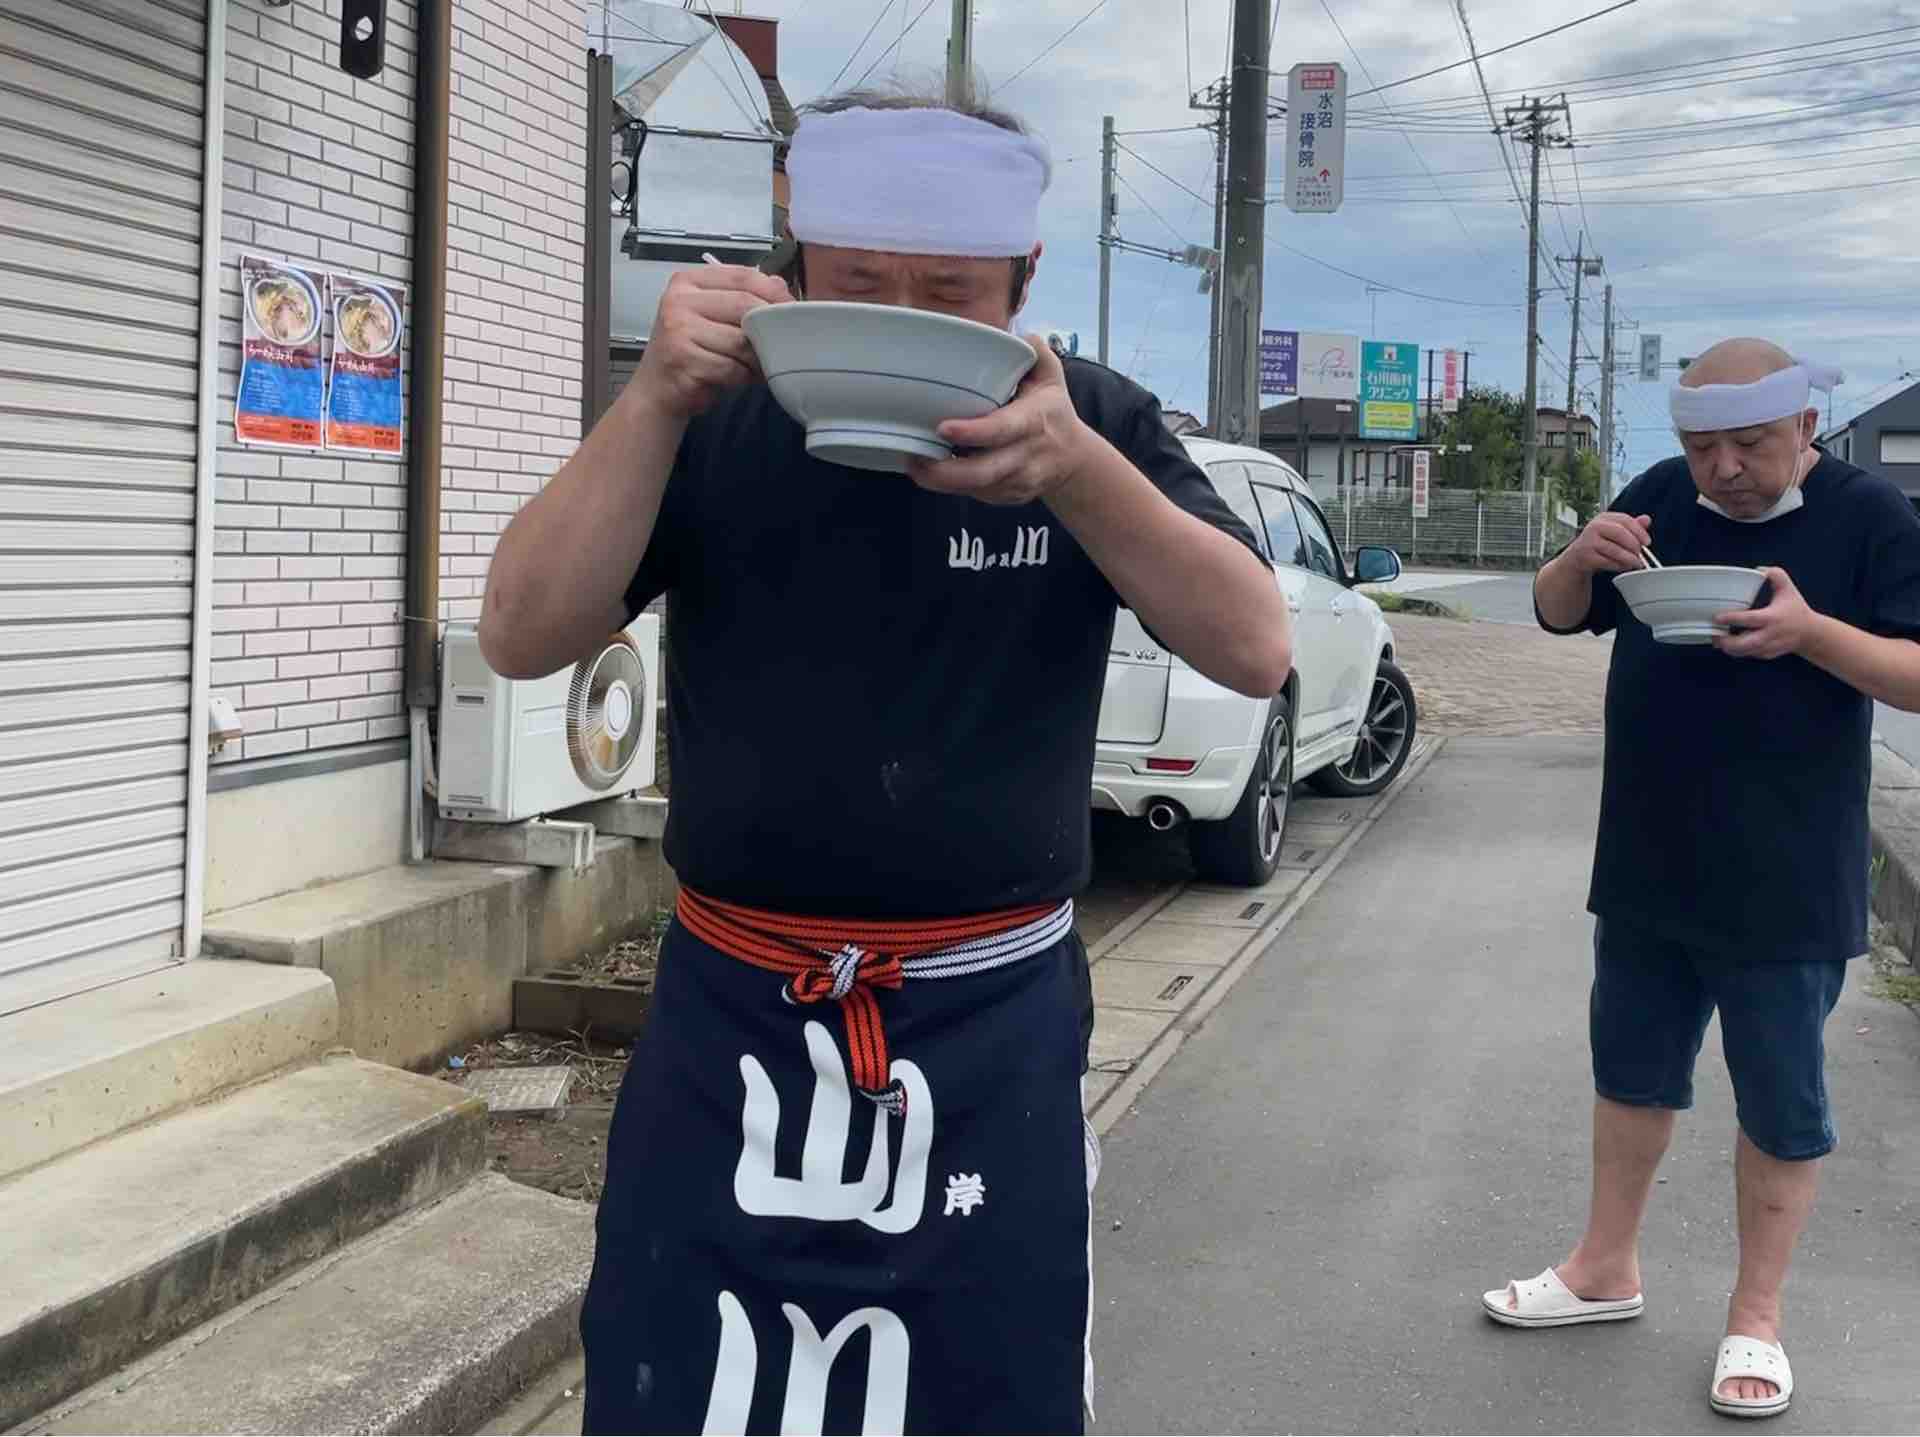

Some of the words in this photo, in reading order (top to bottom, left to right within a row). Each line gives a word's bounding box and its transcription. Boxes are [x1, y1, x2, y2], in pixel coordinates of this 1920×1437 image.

[1297, 112, 1315, 168] 接骨院
[1367, 386, 1409, 400] クリニック
[943, 1171, 986, 1217] 岸
